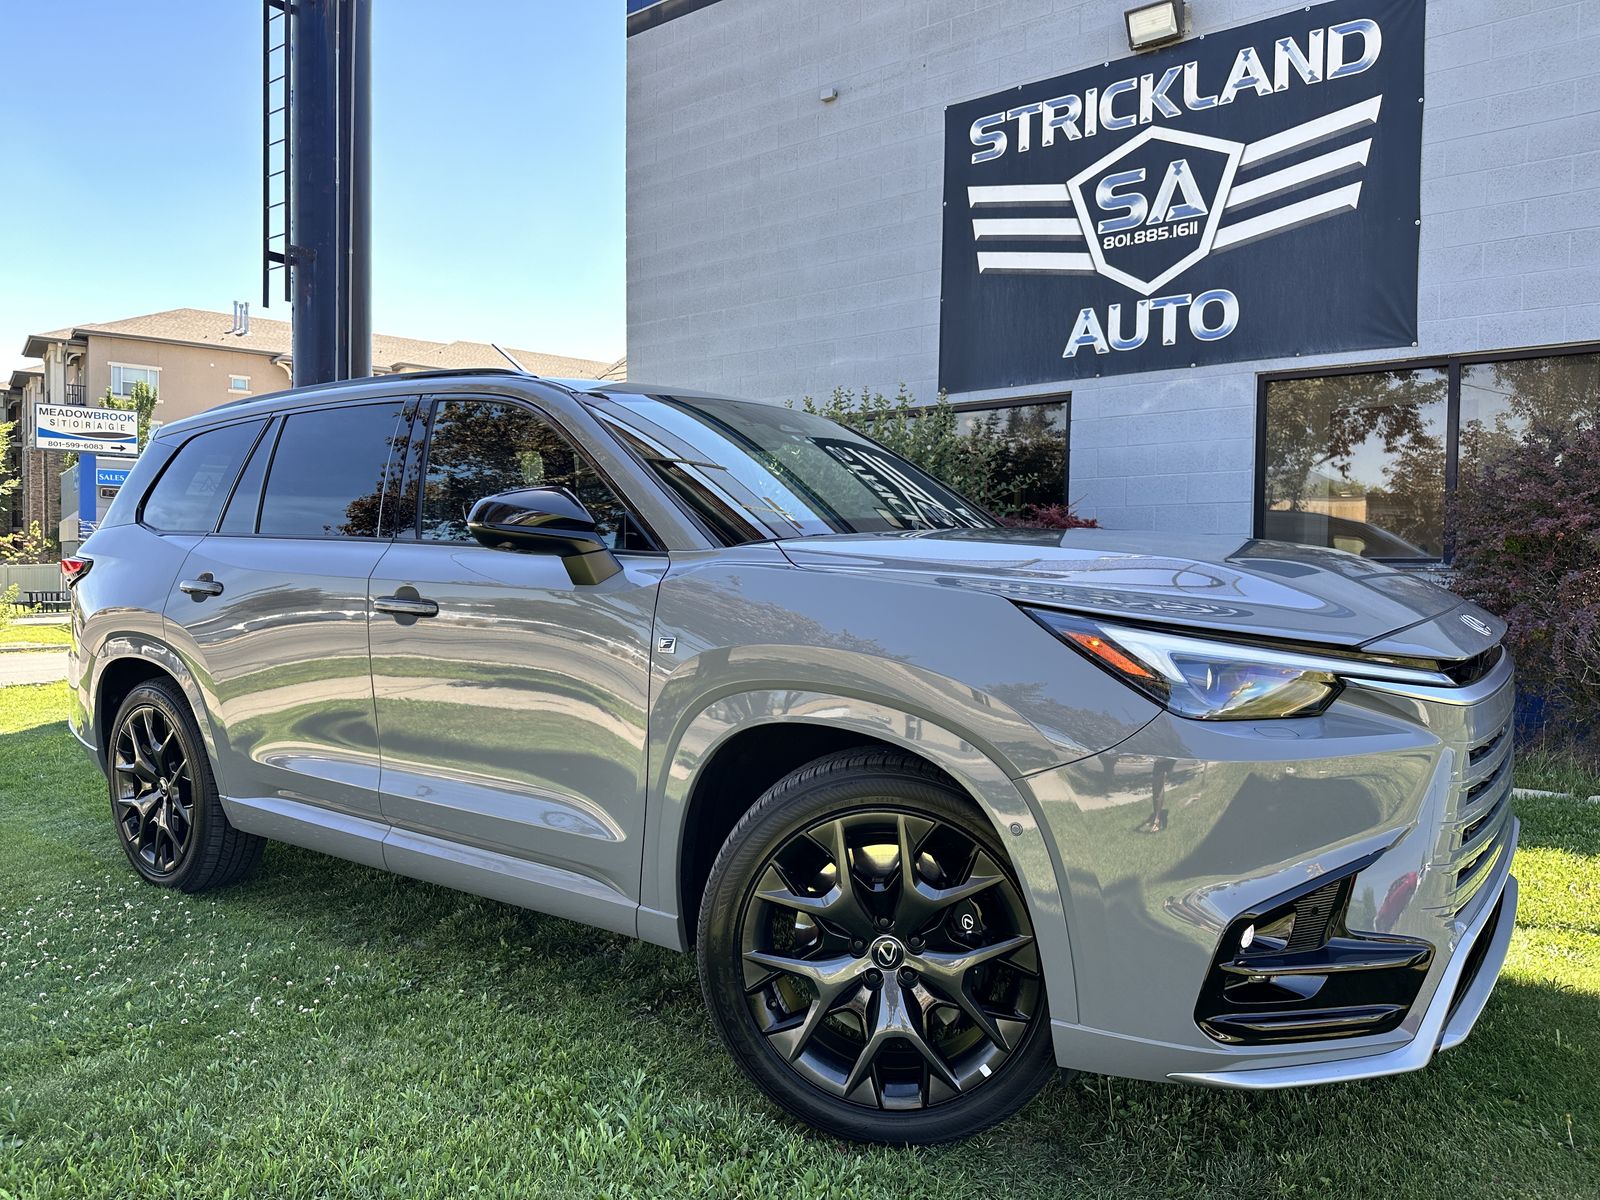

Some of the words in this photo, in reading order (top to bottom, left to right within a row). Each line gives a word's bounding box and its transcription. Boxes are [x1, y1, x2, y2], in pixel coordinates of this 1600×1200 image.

[969, 18, 1382, 164] STRICKLAND
[1095, 158, 1209, 235] SA
[1102, 220, 1199, 250] 801.885.1611
[1061, 288, 1240, 359] AUTO
[39, 408, 135, 422] MEADOWBROOK
[48, 441, 103, 450] 801-599-6083
[98, 473, 125, 481] SALES
